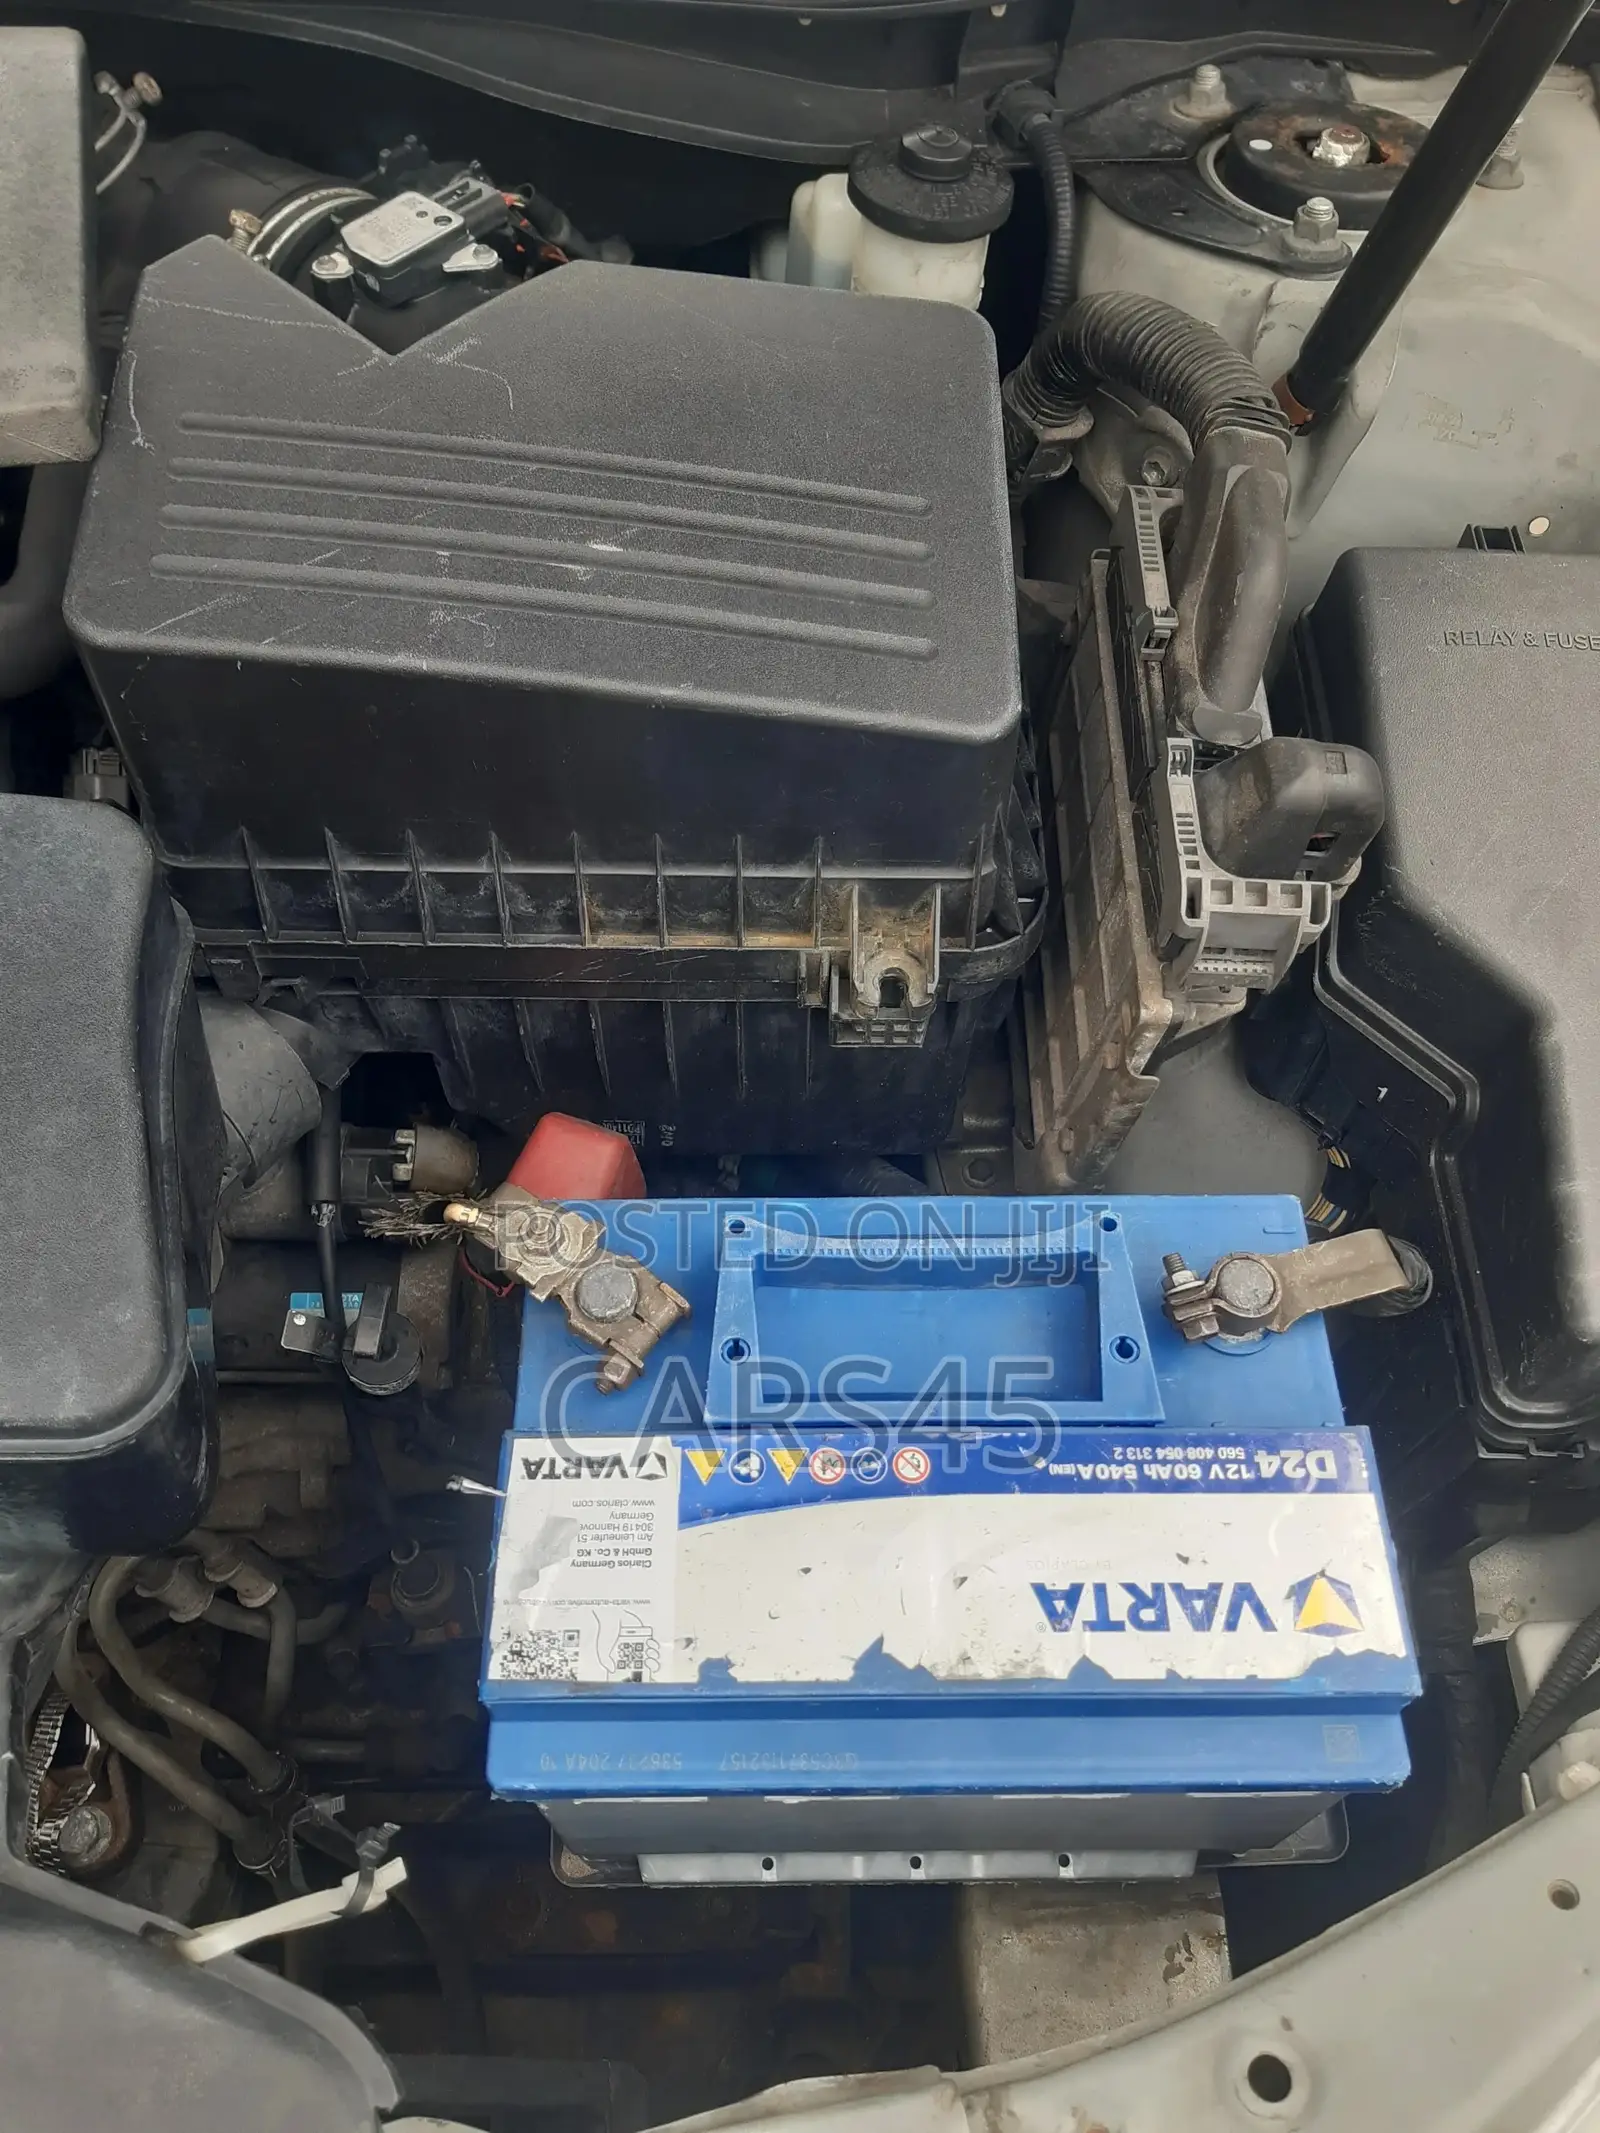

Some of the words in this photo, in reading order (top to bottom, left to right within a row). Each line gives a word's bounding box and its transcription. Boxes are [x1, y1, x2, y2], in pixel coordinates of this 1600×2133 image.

[1443, 629, 1519, 647] RELAY
[1522, 631, 1540, 648] &
[1543, 632, 1600, 651] FUSE
[1126, 1447, 1153, 1460] 313
[1156, 1447, 1184, 1460] 054
[1187, 1447, 1214, 1460] 408
[1254, 1449, 1338, 1479] D24
[1144, 1463, 1199, 1480] 60Ah
[1209, 1463, 1251, 1480] 12V
[572, 1499, 655, 1508] www.clarios.com
[610, 1511, 654, 1521] Germany
[622, 1522, 654, 1531] 30419
[577, 1533, 587, 1542] 51
[590, 1533, 635, 1542] Leineufer
[637, 1533, 653, 1542] Am
[577, 1548, 591, 1557] KG
[594, 1548, 611, 1556] Co.
[612, 1548, 620, 1556] &
[622, 1548, 652, 1557] GmbH
[570, 1558, 615, 1569] Germany
[617, 1560, 652, 1568] Clarios
